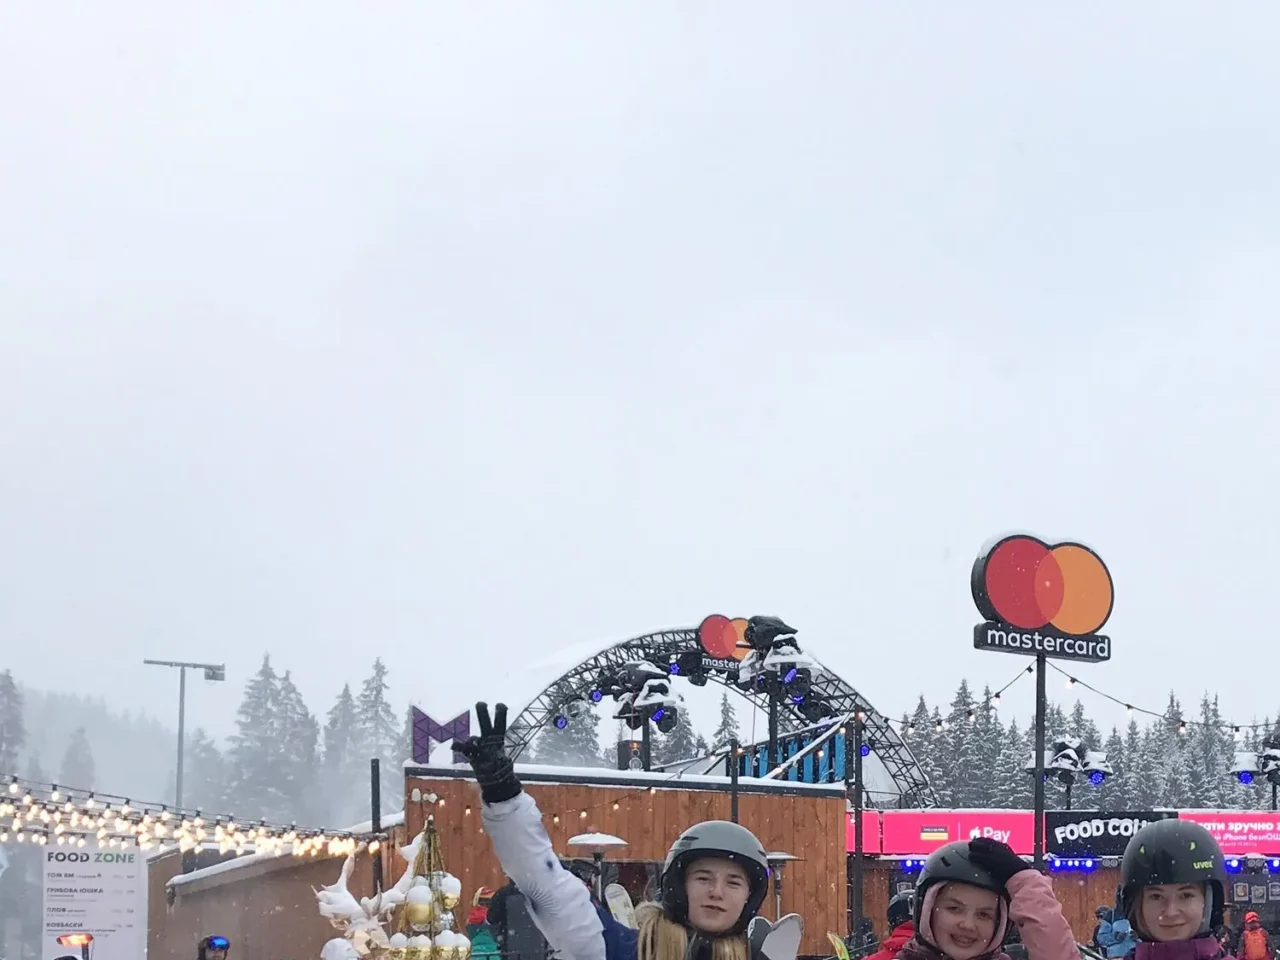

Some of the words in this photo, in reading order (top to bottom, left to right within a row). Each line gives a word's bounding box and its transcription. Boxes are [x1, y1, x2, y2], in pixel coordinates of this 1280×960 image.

[987, 629, 1109, 658] mastercard
[702, 657, 740, 669] master
[1054, 819, 1105, 844] FOOD
[1228, 821, 1274, 834] зручно
[983, 826, 1011, 843] Pay
[47, 851, 90, 863] FOOD
[94, 852, 135, 864] ZONE
[1193, 860, 1213, 870] uvex
